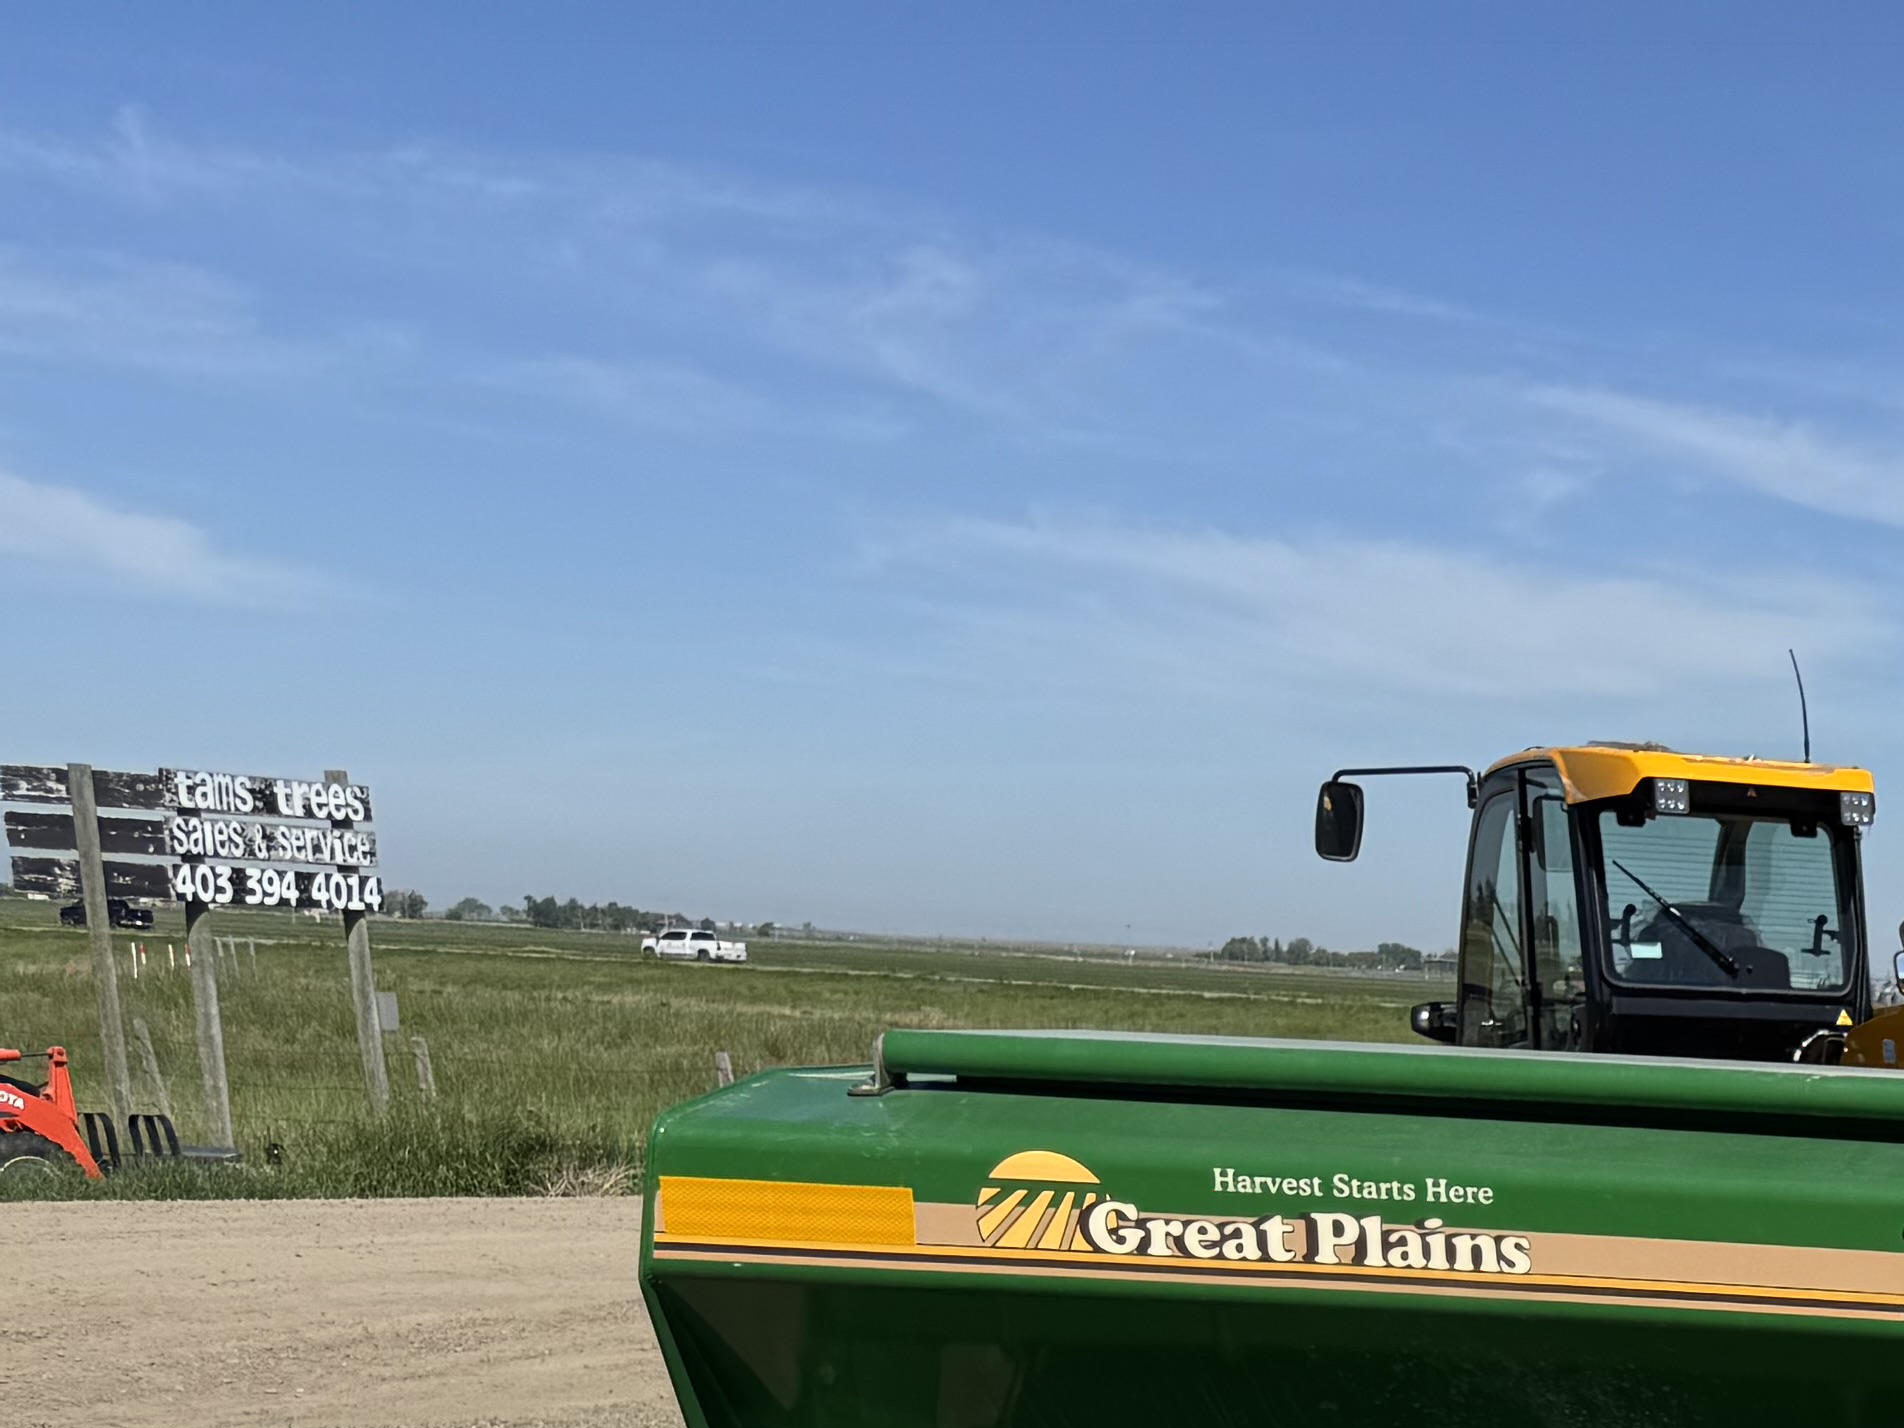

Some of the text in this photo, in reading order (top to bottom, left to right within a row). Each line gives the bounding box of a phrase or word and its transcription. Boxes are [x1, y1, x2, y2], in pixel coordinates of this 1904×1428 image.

[174, 770, 365, 821] tams trees
[172, 817, 371, 866] sales & service
[176, 863, 382, 912] 403 394 4014
[1213, 1167, 1494, 1205] Harvest Starts Here
[1082, 1200, 1533, 1275] Great Plains
